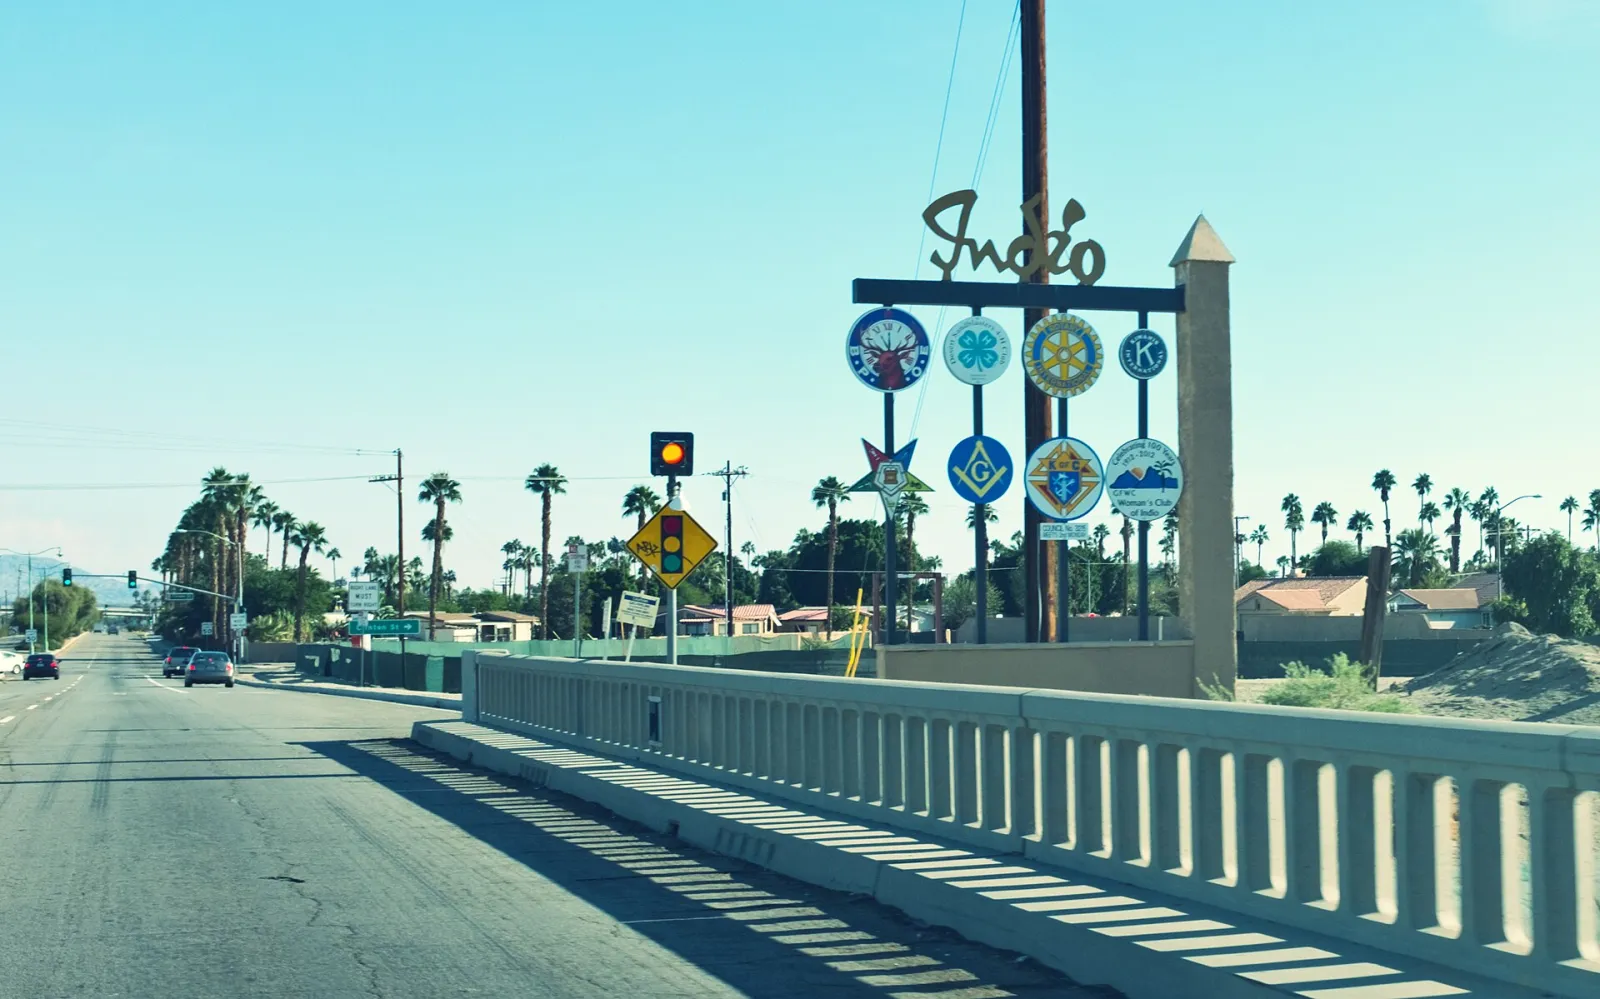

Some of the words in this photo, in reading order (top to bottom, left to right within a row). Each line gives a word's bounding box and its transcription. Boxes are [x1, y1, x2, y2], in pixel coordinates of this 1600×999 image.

[922, 189, 1106, 284] Indio
[1135, 340, 1154, 367] K
[1112, 441, 1146, 466] Celebrating
[1148, 442, 1162, 451] 100
[1049, 461, 1057, 470] K
[1072, 461, 1081, 470] C
[971, 461, 990, 482] G
[1112, 489, 1136, 497] GFWC
[1117, 499, 1153, 507] Woman's
[1154, 499, 1173, 507] Club
[1130, 509, 1138, 517] of
[1140, 509, 1160, 517] Indio
[390, 623, 399, 631] St
